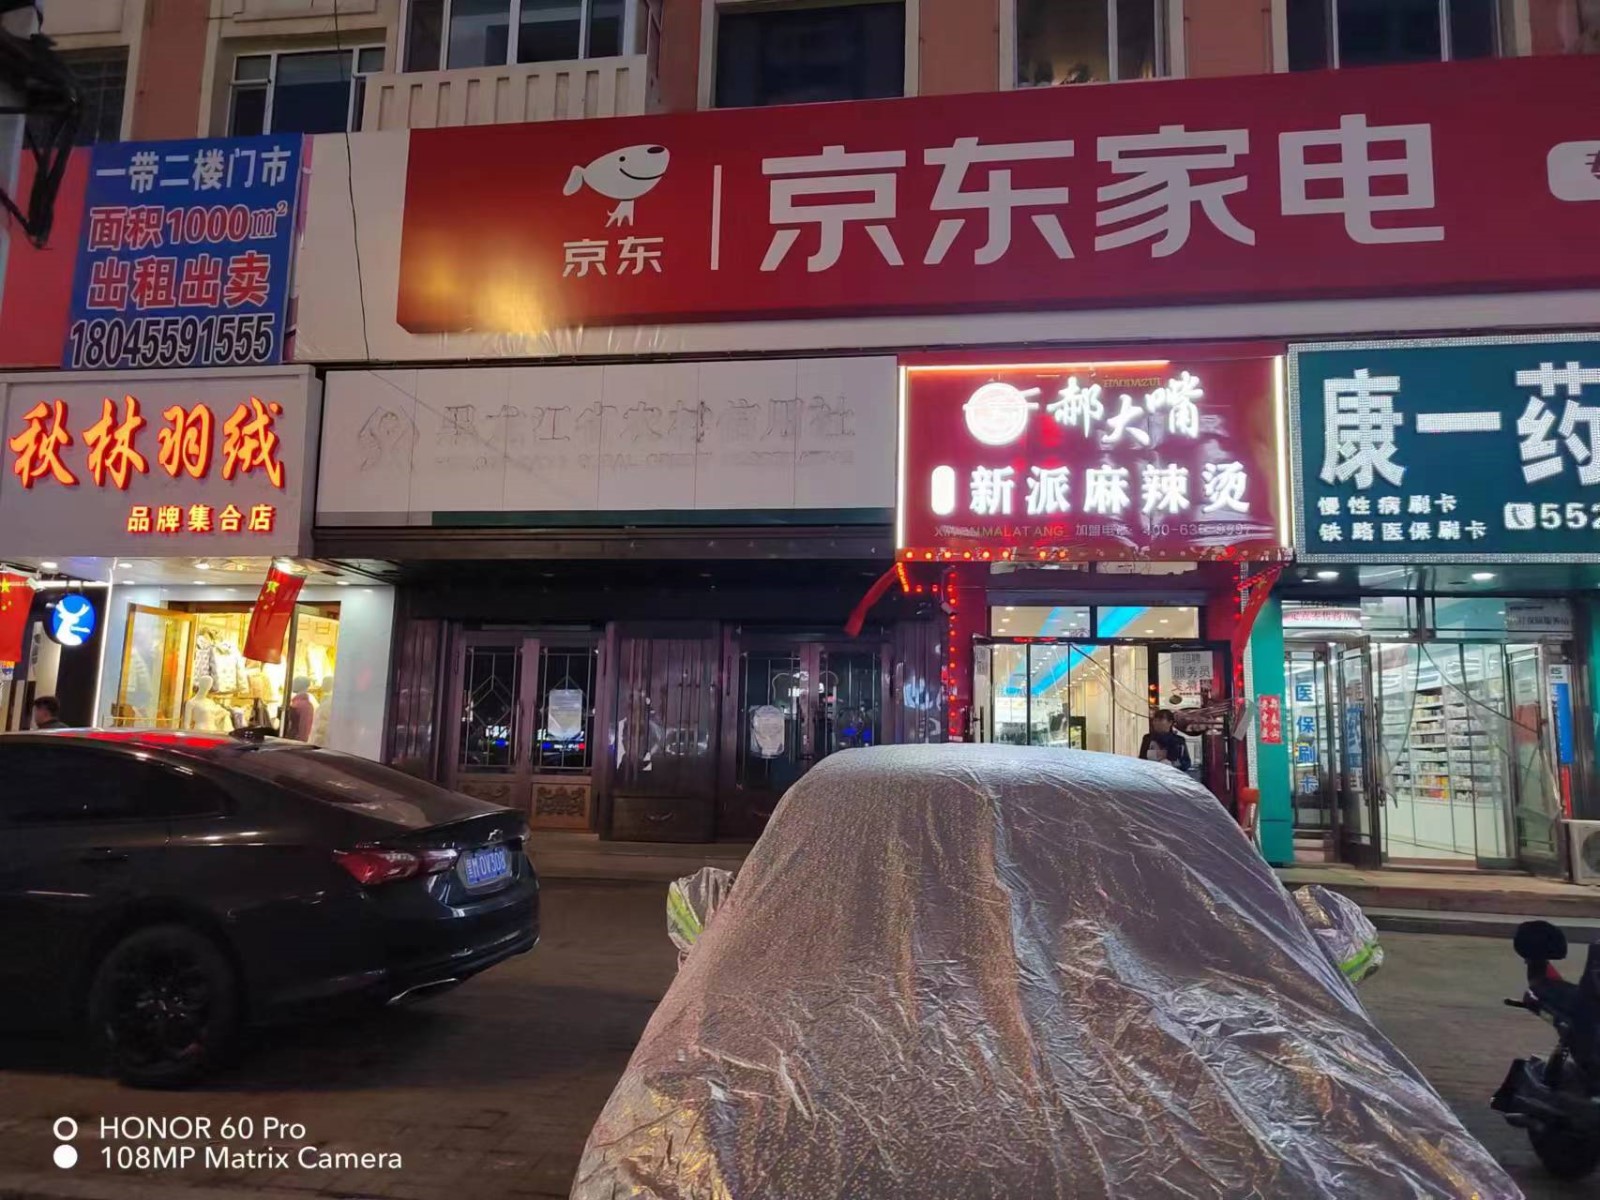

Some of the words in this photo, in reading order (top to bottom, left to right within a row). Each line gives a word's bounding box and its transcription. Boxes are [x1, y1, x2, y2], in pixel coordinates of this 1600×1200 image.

[96, 145, 292, 194] 一带二楼门市
[759, 114, 1445, 273] 京东家电
[86, 250, 271, 311] 出租出卖
[562, 236, 665, 278] 京东
[70, 313, 275, 368] 18045591555
[1047, 370, 1205, 446] 郝大嘴
[1319, 361, 1600, 490] 康一药
[8, 394, 286, 490] 秋林羽绒
[968, 460, 1251, 516] 新派麻辣烫
[1317, 494, 1457, 516] 慢性病刷卡
[127, 503, 275, 533] 品牌集合店
[1319, 521, 1488, 542] 铁路医保刷卡
